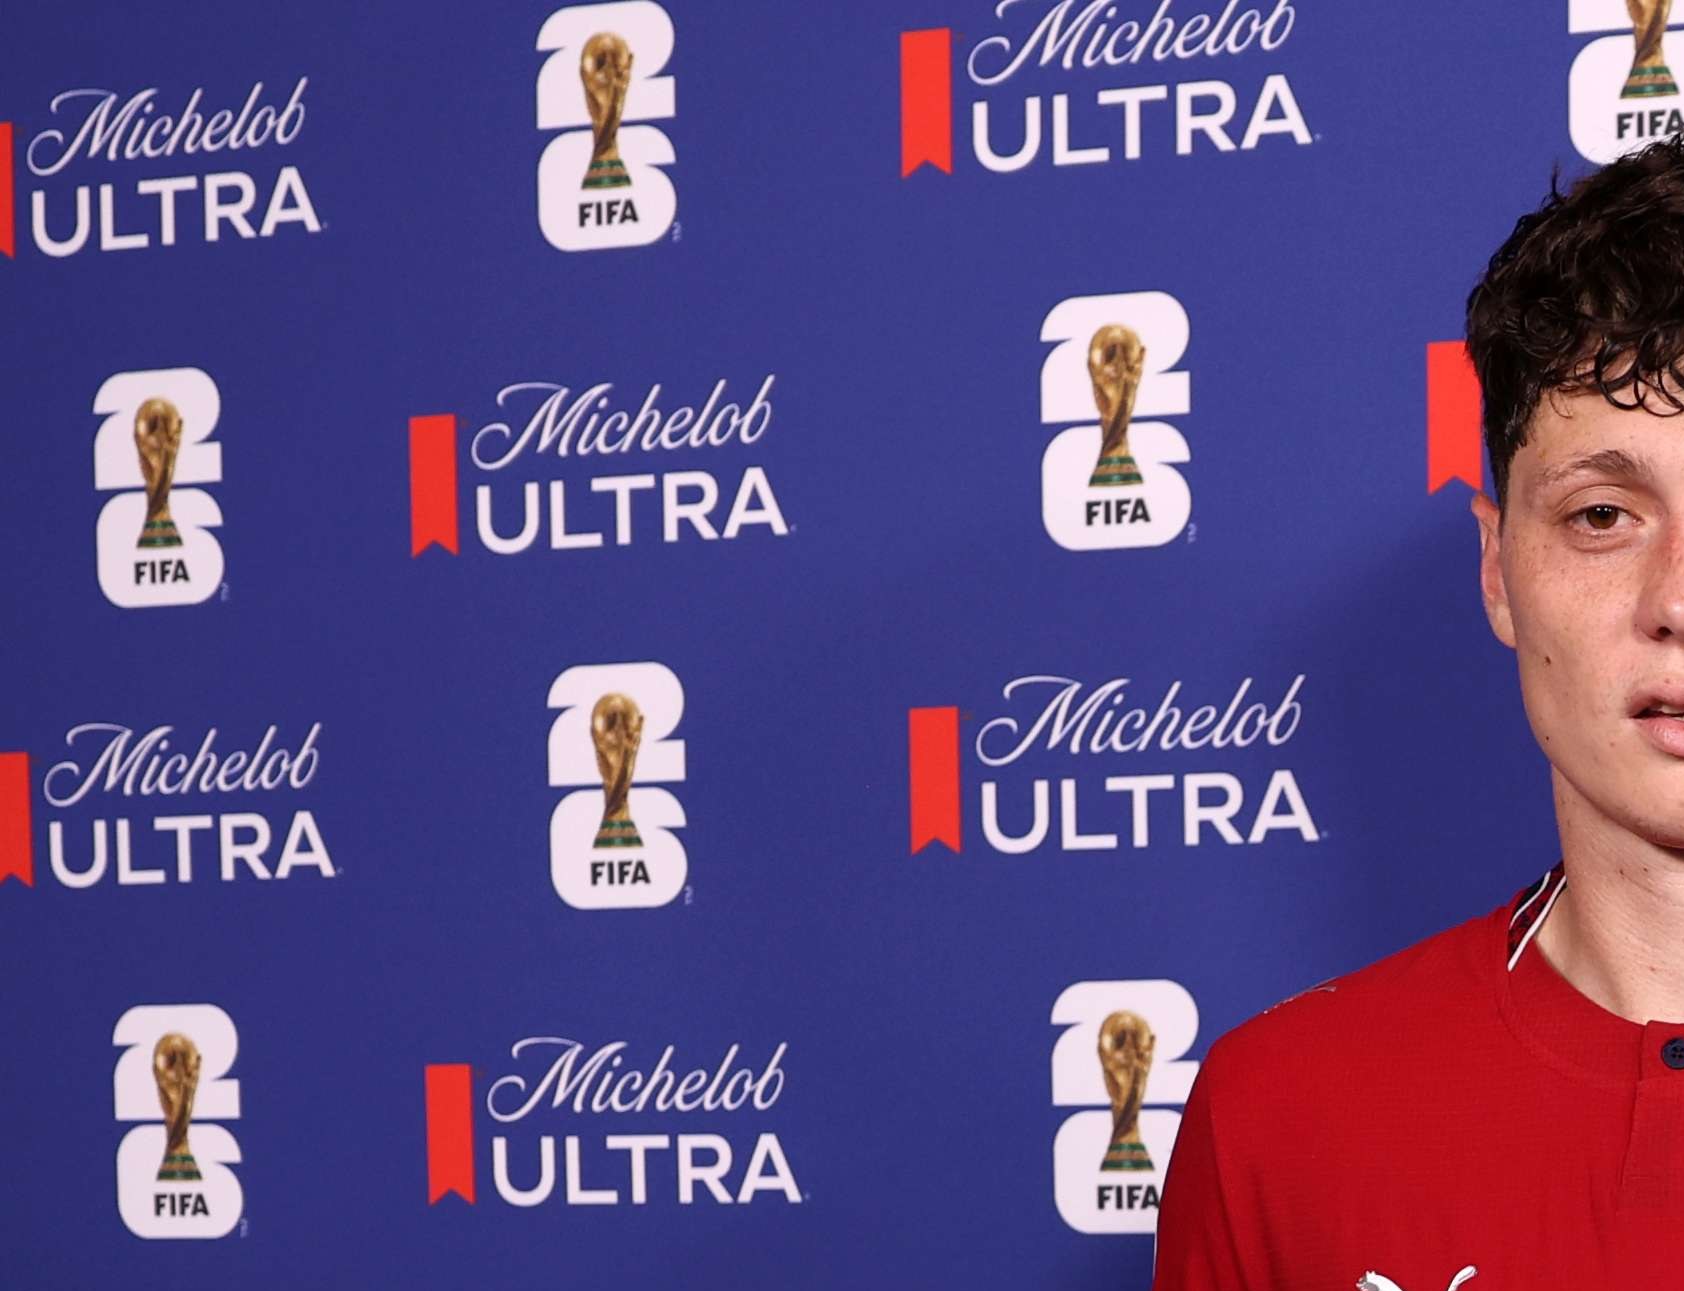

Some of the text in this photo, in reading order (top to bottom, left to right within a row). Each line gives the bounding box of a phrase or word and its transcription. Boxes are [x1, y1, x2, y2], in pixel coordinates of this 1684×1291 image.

[967, 0, 1296, 86] Michelob
[27, 77, 308, 176] Michelob
[972, 74, 1313, 173] ULTRA
[32, 167, 320, 257] ULTRA
[579, 200, 639, 227] FIFA
[470, 375, 775, 470] Michelob
[476, 467, 788, 554] ULTRA
[1086, 499, 1151, 526] FIFA
[134, 560, 190, 585] FIFA
[976, 675, 1306, 766] Michelob
[44, 722, 321, 806] Michelob
[49, 811, 336, 888] ULTRA
[981, 770, 1319, 853] ULTRA
[590, 861, 651, 886] FIFA
[487, 1037, 787, 1122] Michelob
[154, 1193, 209, 1217] FIFA
[493, 1133, 802, 1206] ULTRA
[1097, 1185, 1160, 1210] FIFA
